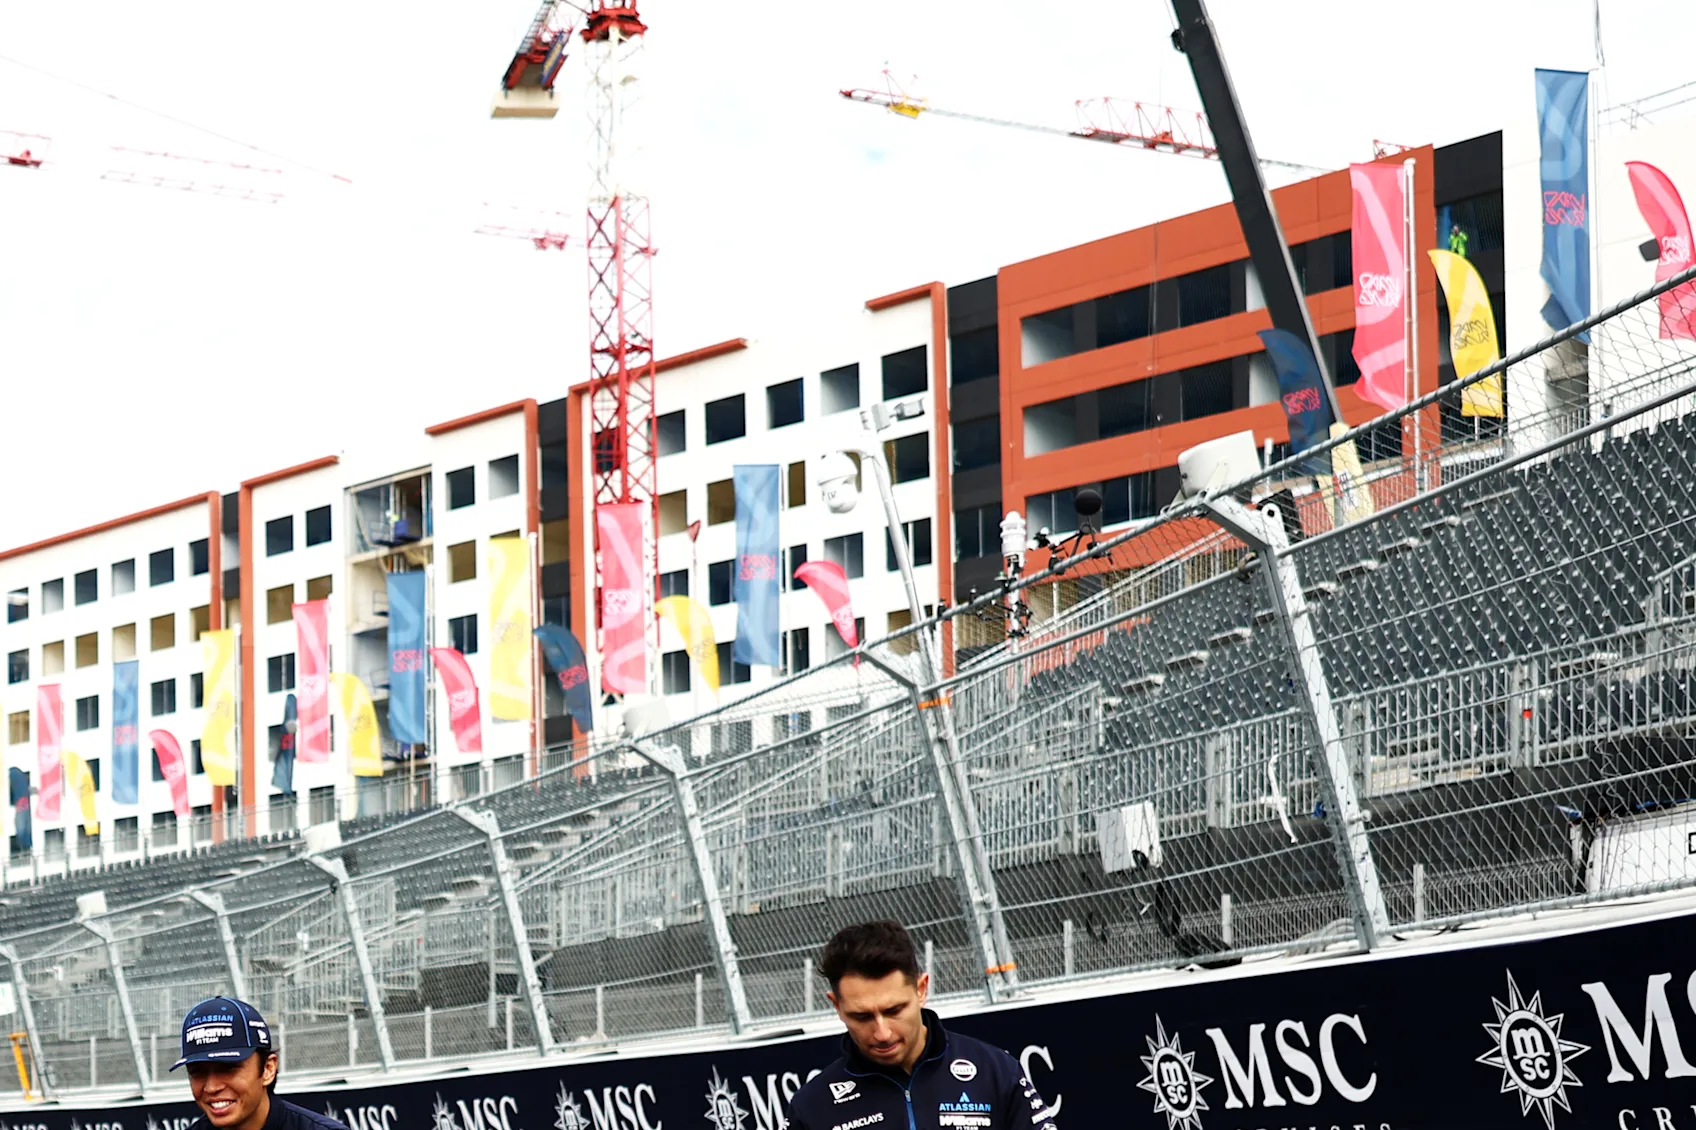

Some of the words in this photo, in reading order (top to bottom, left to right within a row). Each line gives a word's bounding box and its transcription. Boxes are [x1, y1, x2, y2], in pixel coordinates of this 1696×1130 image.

[186, 1027, 233, 1043] Williams
[1205, 1012, 1378, 1109] MSC
[939, 1103, 991, 1112] ATLASSIAN
[939, 1115, 991, 1127] Williams
